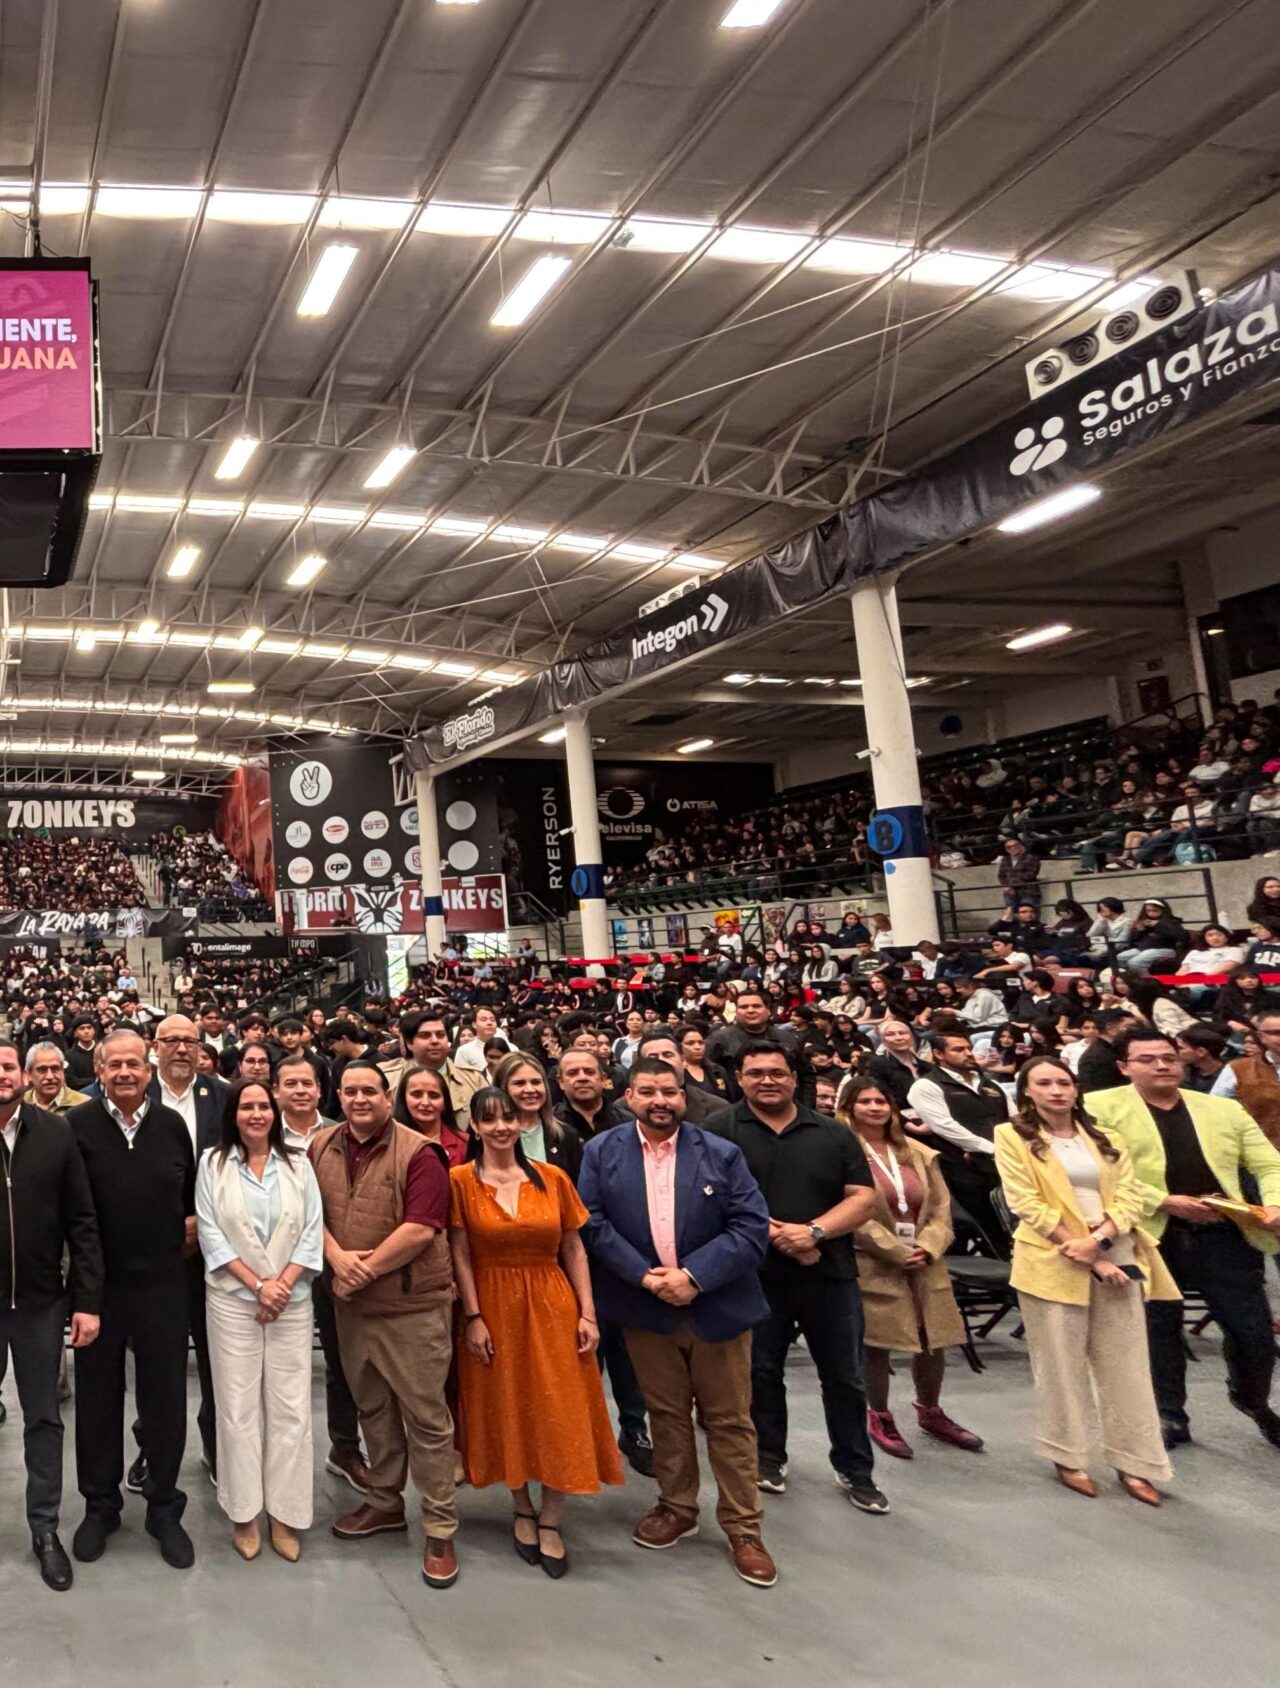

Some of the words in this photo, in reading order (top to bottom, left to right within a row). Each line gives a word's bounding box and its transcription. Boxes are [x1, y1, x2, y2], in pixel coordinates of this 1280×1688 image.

[1083, 390, 1172, 446] Seguros
[1180, 382, 1194, 402] y
[632, 614, 698, 660] Integon
[456, 708, 493, 738] Florido
[7, 800, 136, 828] ZONKEYS
[682, 800, 718, 810] ATISA
[541, 787, 563, 889] RYERSON
[598, 822, 652, 833] elevisa
[409, 888, 503, 911] ZNKEYS
[16, 915, 36, 937] LA
[204, 943, 252, 952] entalimage
